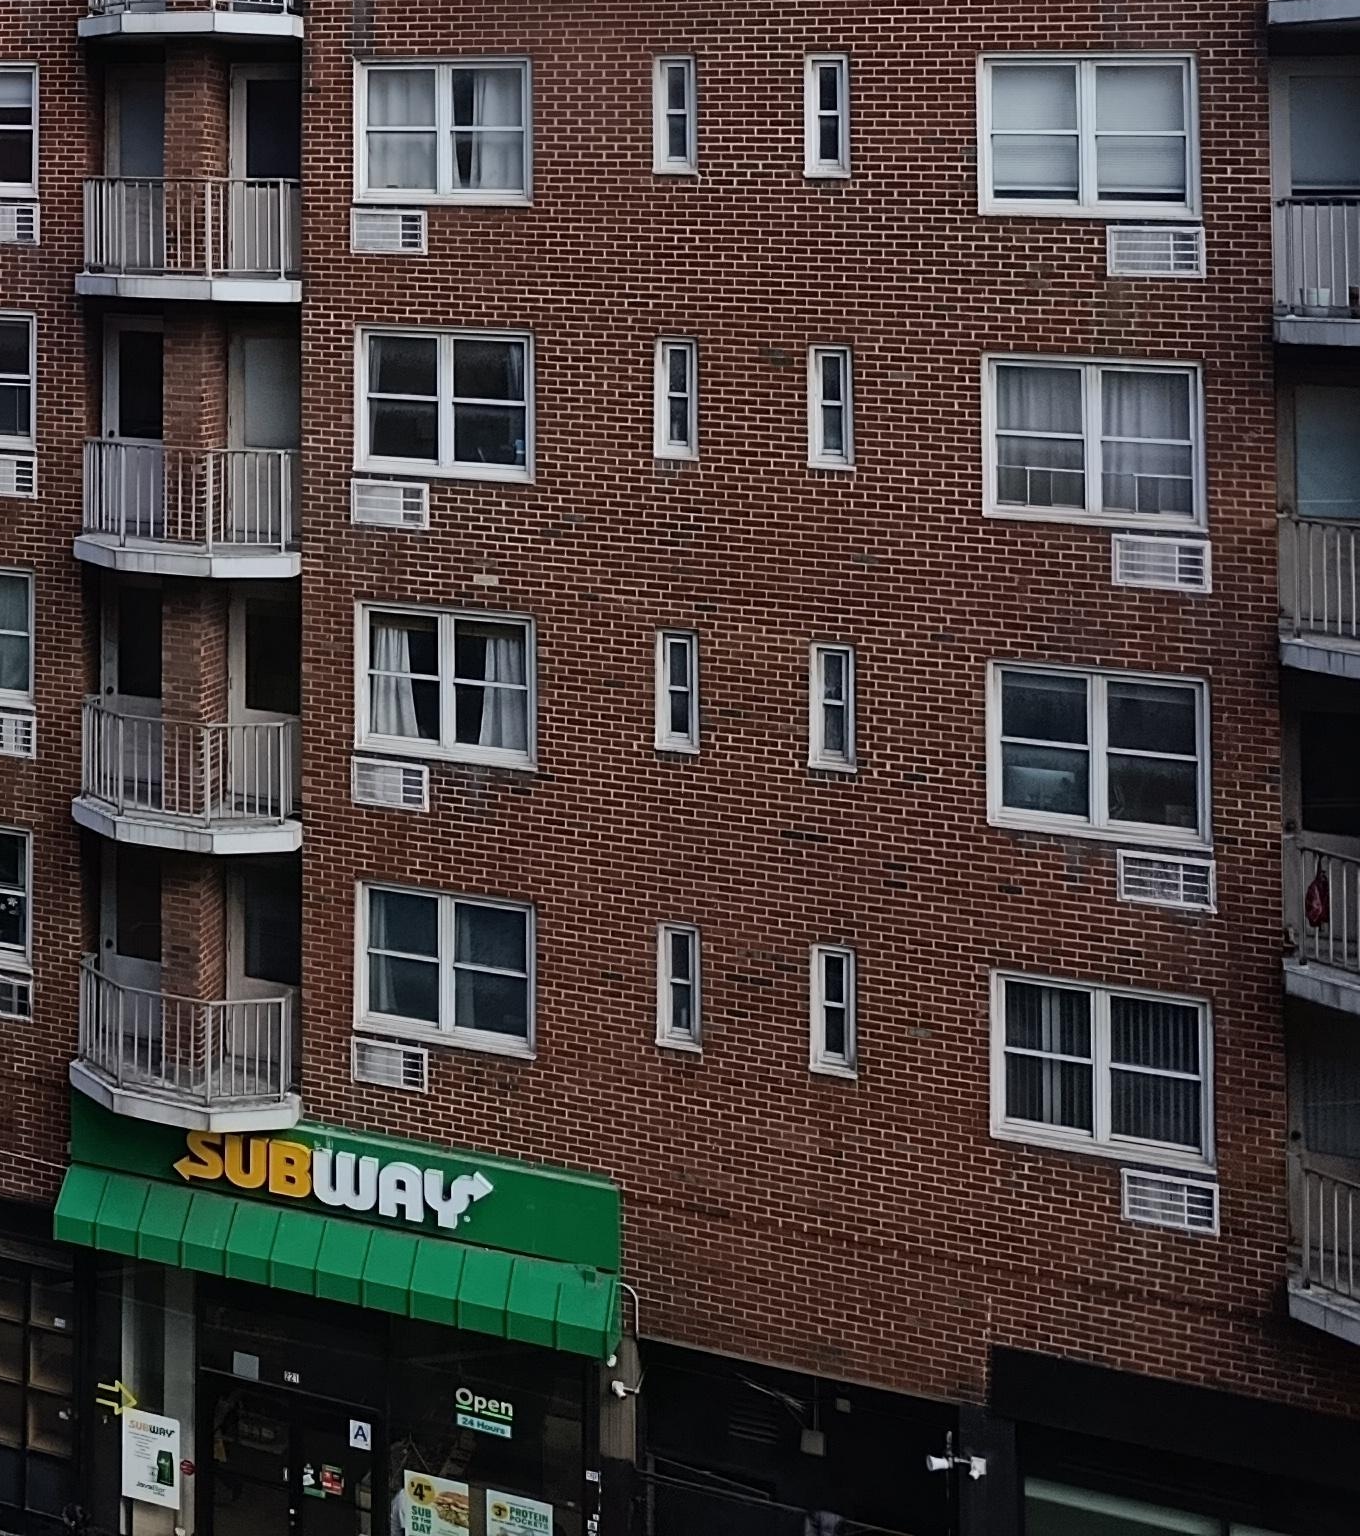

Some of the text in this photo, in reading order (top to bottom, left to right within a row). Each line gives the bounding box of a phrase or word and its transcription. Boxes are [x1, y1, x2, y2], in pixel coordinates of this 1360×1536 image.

[173, 1130, 494, 1229] SUBWAY
[284, 1370, 300, 1384] 221
[455, 1387, 514, 1417] Open
[128, 1420, 176, 1438] SUBWAY
[353, 1425, 368, 1443] A
[462, 1416, 506, 1435] 24 Hours
[411, 1505, 432, 1518] SUB
[510, 1506, 549, 1523] PROTEIN
[411, 1521, 432, 1535] DAY
[510, 1515, 549, 1530] POCKETS
